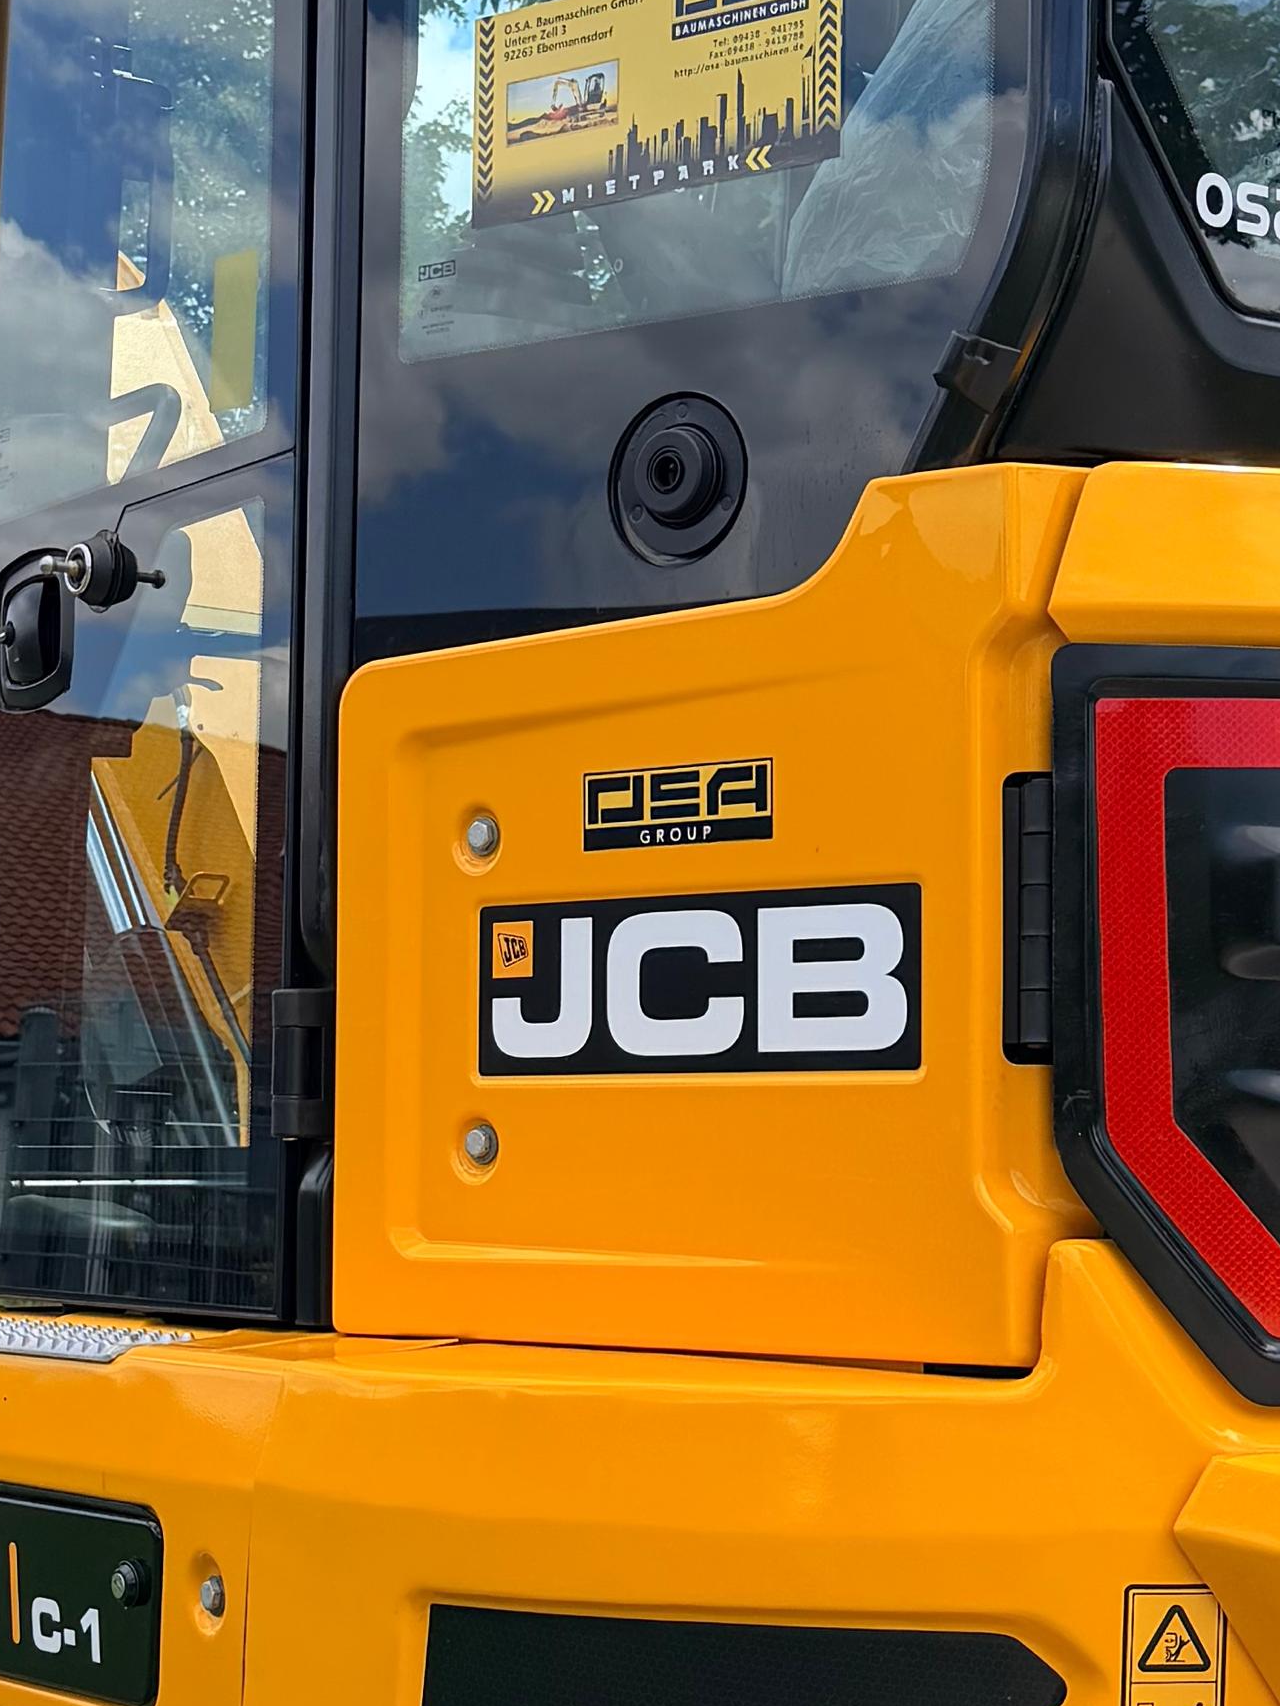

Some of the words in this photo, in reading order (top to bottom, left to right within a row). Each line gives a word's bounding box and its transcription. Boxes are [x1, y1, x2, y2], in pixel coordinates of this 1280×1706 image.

[504, 21, 533, 35] O.S.A.
[536, 4, 608, 27] Baumaschinen
[674, 5, 767, 37] BAUMASCHINEN
[503, 46, 534, 62] 92263
[536, 25, 614, 54] Ebermannsdorf
[504, 35, 537, 48] Untere
[540, 27, 558, 40] Zell
[560, 24, 567, 35] 3
[713, 37, 730, 48] Tel:
[561, 154, 740, 205] MIETPARK
[419, 260, 455, 281] JCB
[639, 825, 713, 844] GROUP
[502, 935, 527, 963] JCB
[491, 903, 908, 1058] JCB
[31, 1596, 102, 1664] C-1
